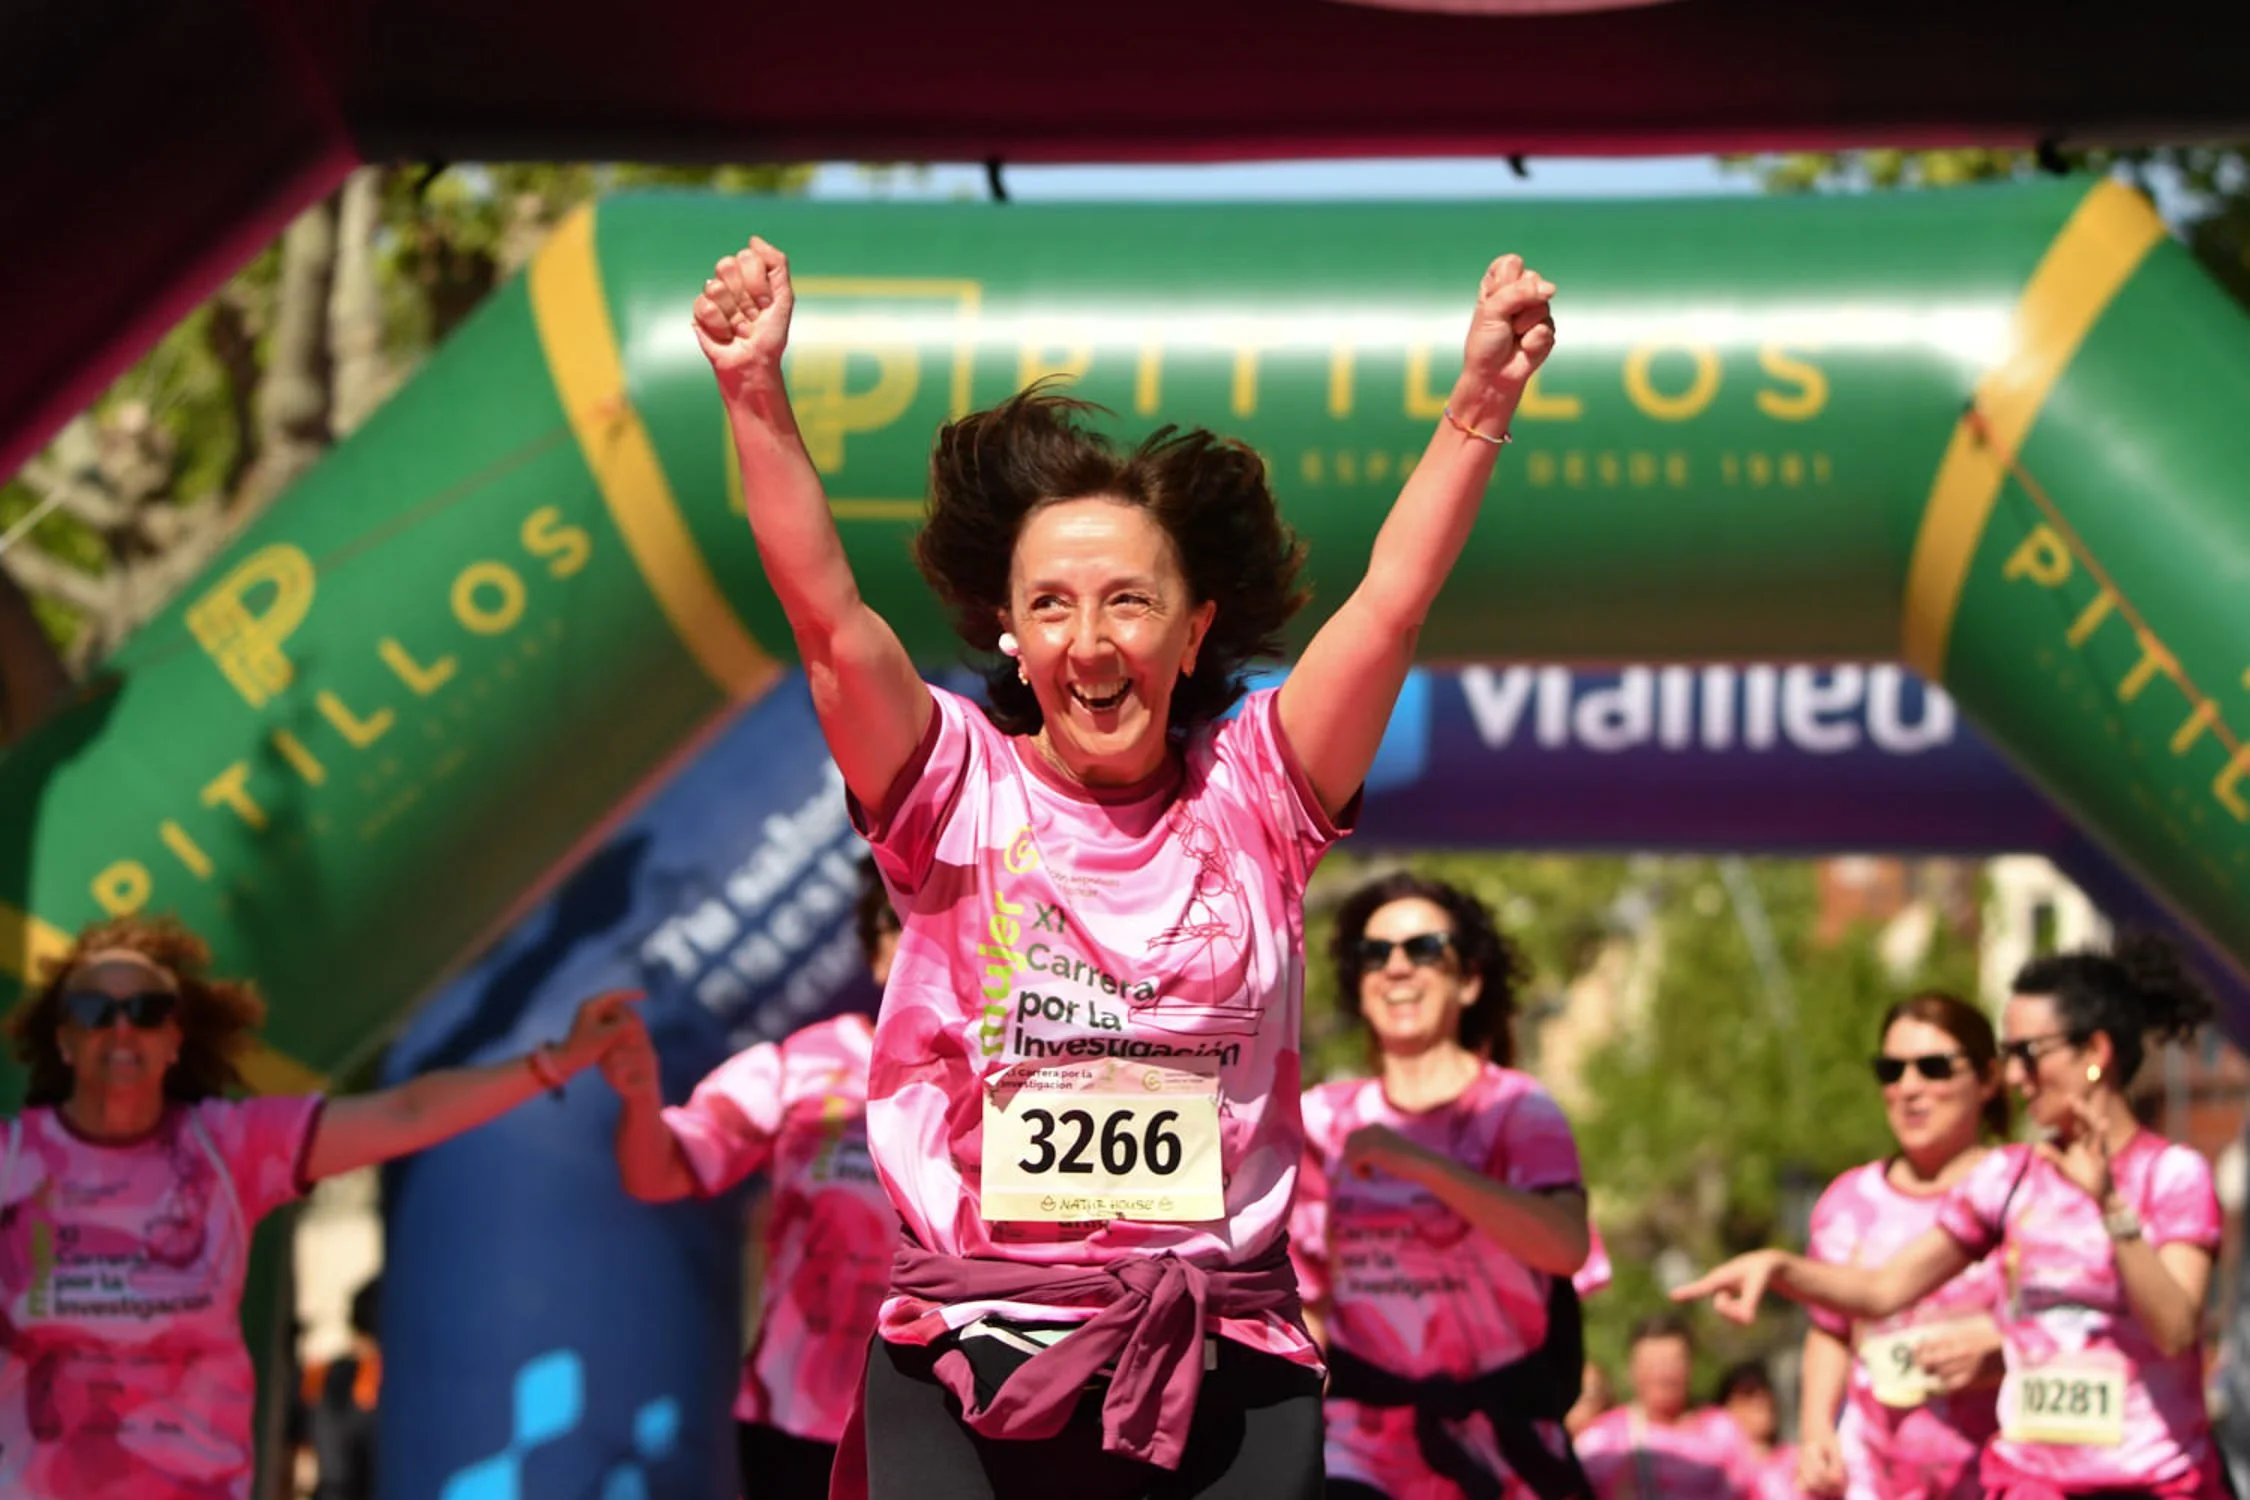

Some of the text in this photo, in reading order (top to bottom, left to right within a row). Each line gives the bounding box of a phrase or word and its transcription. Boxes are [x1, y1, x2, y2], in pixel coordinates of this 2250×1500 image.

[1016, 322, 1831, 421] PITILLOS
[91, 505, 592, 916] PITILLOS
[1031, 902, 1067, 933] XI
[977, 890, 1028, 1057] mujer
[1026, 942, 1156, 1001] Carrera
[1016, 989, 1122, 1031] por la
[1018, 1069, 1058, 1078] Carrera
[1061, 1069, 1079, 1081] por
[1081, 1068, 1093, 1079] la
[1017, 1108, 1183, 1176] 3266
[2021, 1378, 2111, 1416] 10281
